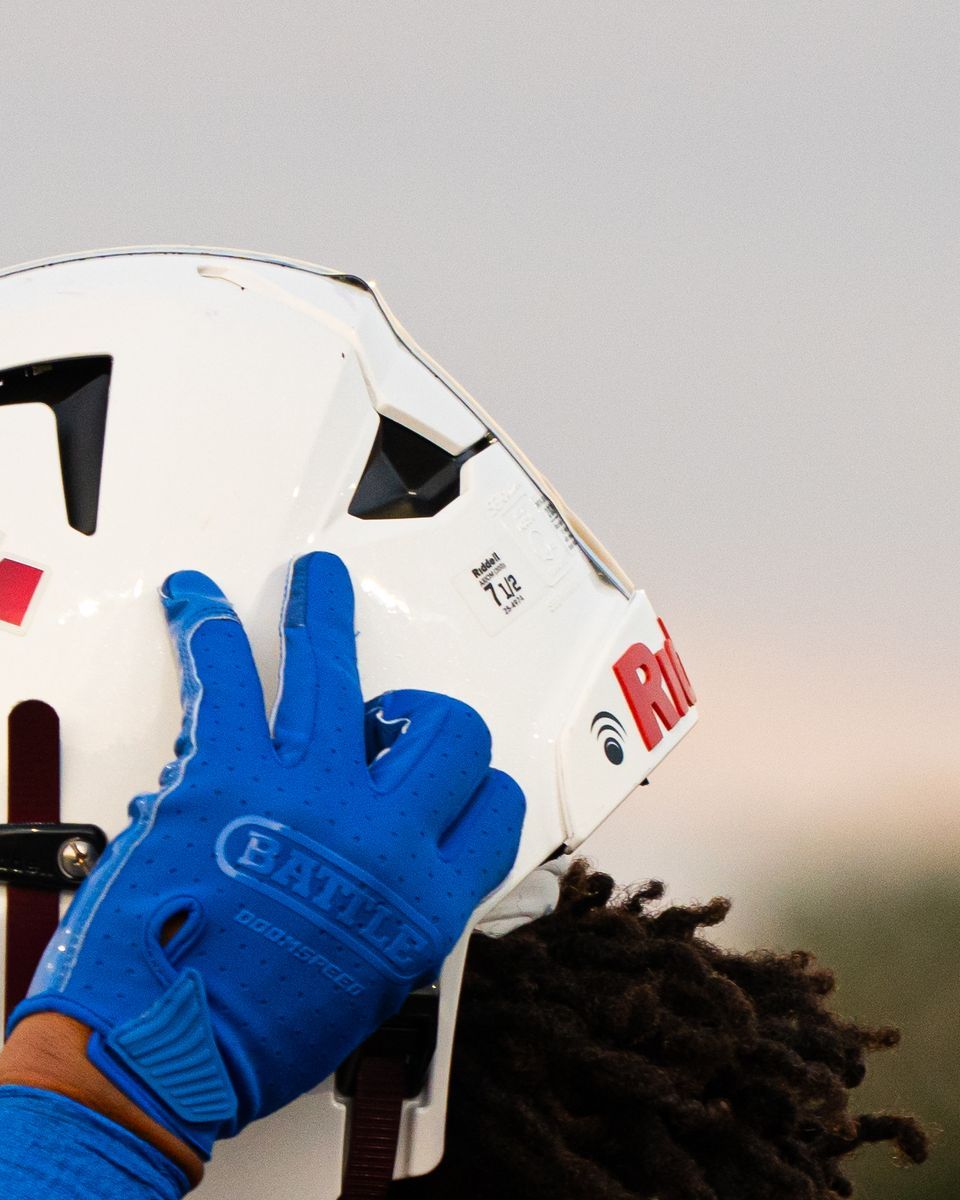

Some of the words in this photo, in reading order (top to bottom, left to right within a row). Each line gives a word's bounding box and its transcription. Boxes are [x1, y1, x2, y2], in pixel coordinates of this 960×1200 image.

[471, 551, 501, 579] Riddell
[483, 582, 502, 607] 7
[498, 574, 522, 600] 1/2
[237, 830, 429, 968] BATTLE
